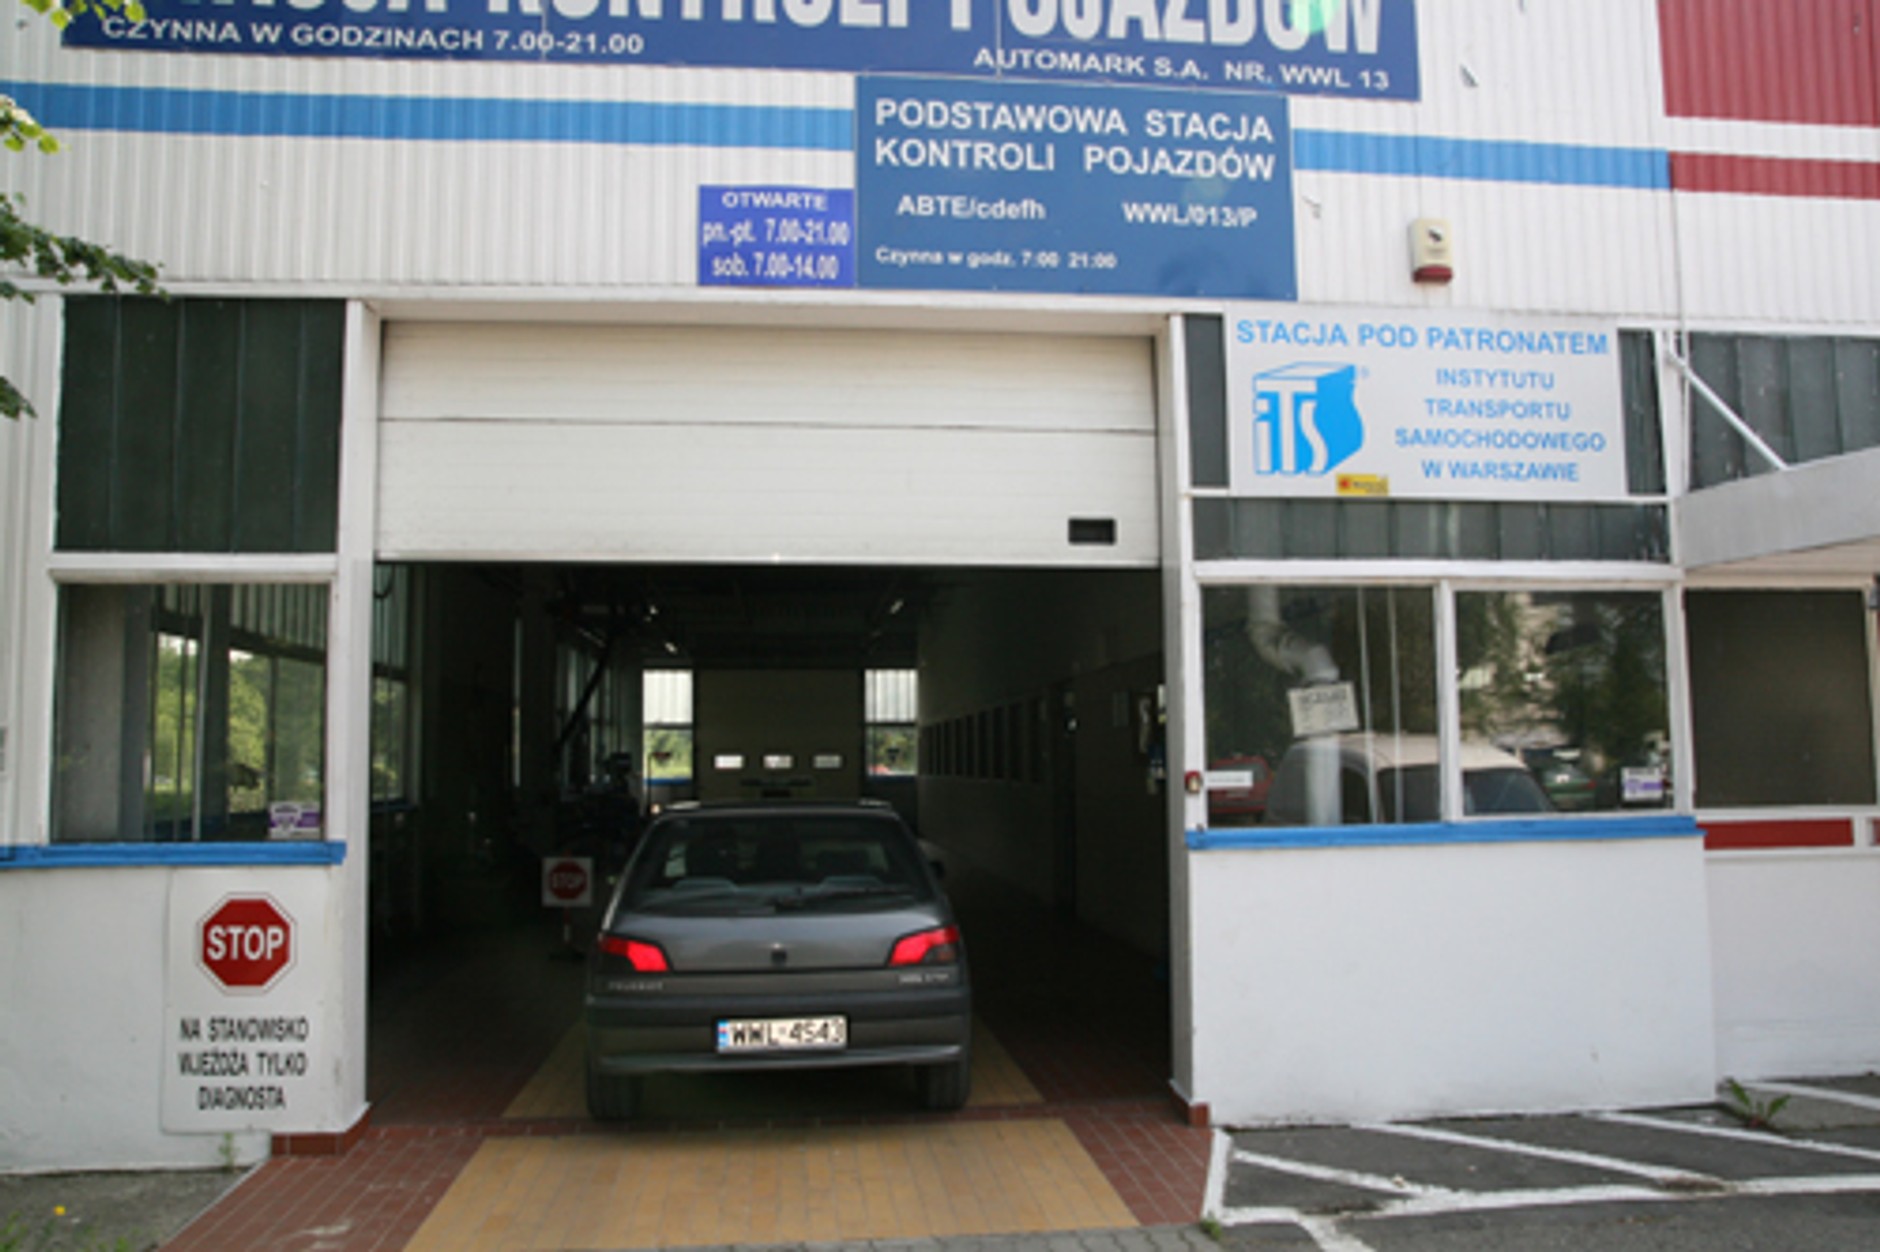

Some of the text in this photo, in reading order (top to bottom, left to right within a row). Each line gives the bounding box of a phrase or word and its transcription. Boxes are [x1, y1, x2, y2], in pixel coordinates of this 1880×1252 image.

[102, 15, 645, 55] CZYNNA W GODZINACH 7.00-21.00
[974, 46, 1391, 91] AUTOMARK S.A. NR. WWL 13
[875, 98, 1273, 143] PODSTAWOWA STACJA
[875, 138, 1276, 182] KONTROLI POJAZDÓW
[722, 191, 828, 211] OTWARTE
[897, 194, 1046, 220] ABTE/cdefh
[765, 217, 851, 246] 7.00-21.00
[712, 251, 839, 280] sob. 7.00-14.00
[875, 246, 945, 267] Czynna
[947, 251, 964, 265] w
[967, 250, 1017, 269] godz.
[1067, 252, 1118, 269] 21:00
[1236, 319, 1609, 355] STACJA POD PATRONATEM
[1436, 368, 1555, 391] INSTYTUTU
[1425, 398, 1572, 421] TRANSPORTU
[1394, 427, 1607, 453] SAMOCHODOWEGO
[1421, 459, 1580, 482] W WARSZAWIE
[206, 924, 284, 961] STOP
[179, 1017, 309, 1043] NA STANOWISKO
[257, 1052, 307, 1076] TYLKO
[198, 1085, 286, 1110] DIAGNOSTA
